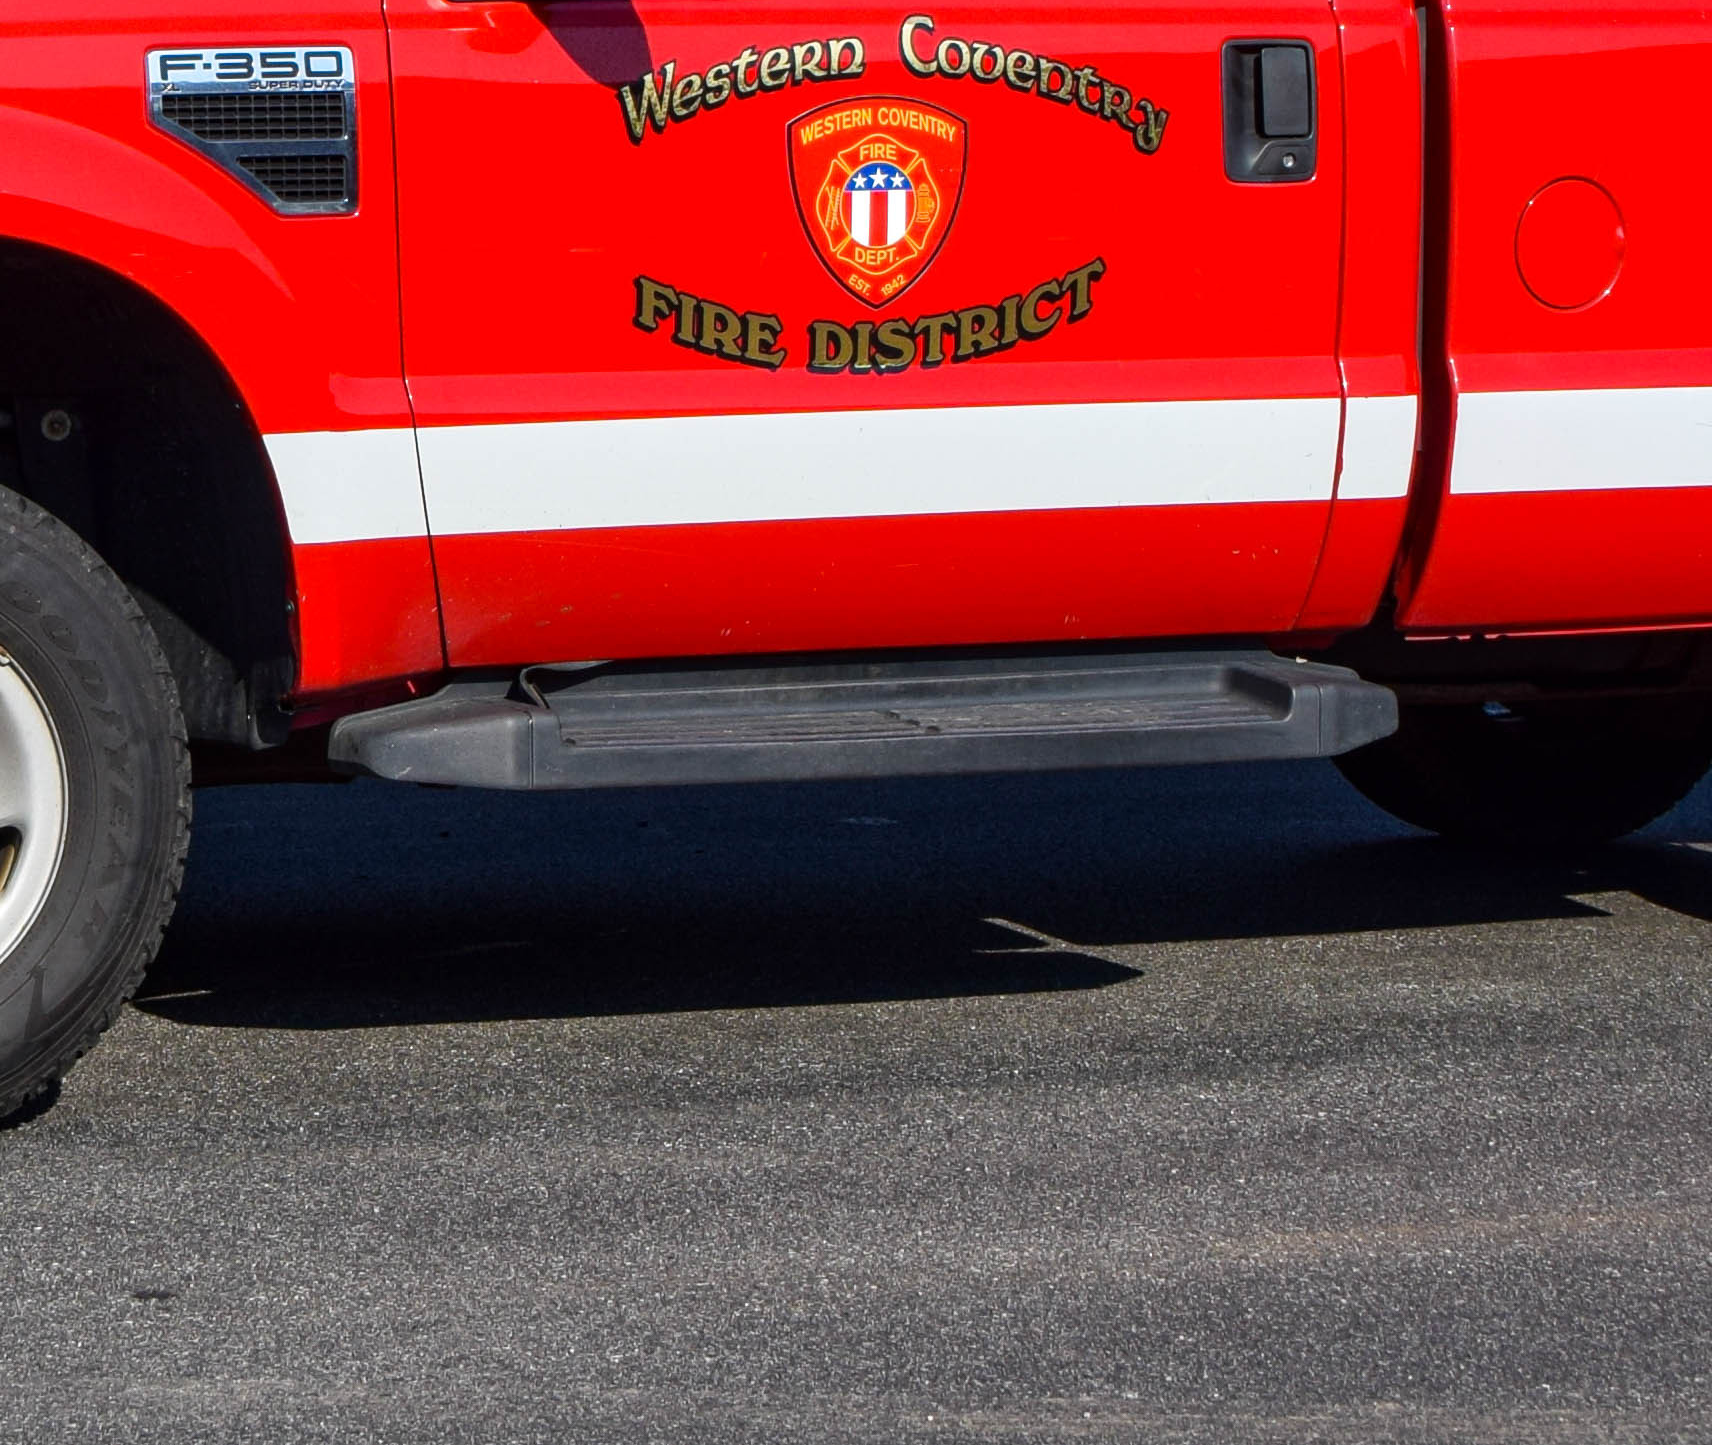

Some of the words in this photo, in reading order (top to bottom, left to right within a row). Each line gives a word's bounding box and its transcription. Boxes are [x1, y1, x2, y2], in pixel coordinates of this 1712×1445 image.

[248, 80, 299, 90] SUPER
[302, 79, 345, 90] DUTY
[620, 37, 865, 144] Western
[899, 14, 1168, 153] Coventry
[800, 107, 872, 145] WESTERN
[877, 107, 956, 142] COVENTRY
[859, 143, 897, 161] FIRE
[854, 247, 899, 265] DEPT.
[848, 274, 871, 296] EST.
[881, 273, 907, 296] 1942
[635, 275, 786, 370] FIRE
[806, 258, 1106, 373] DISTRICT
